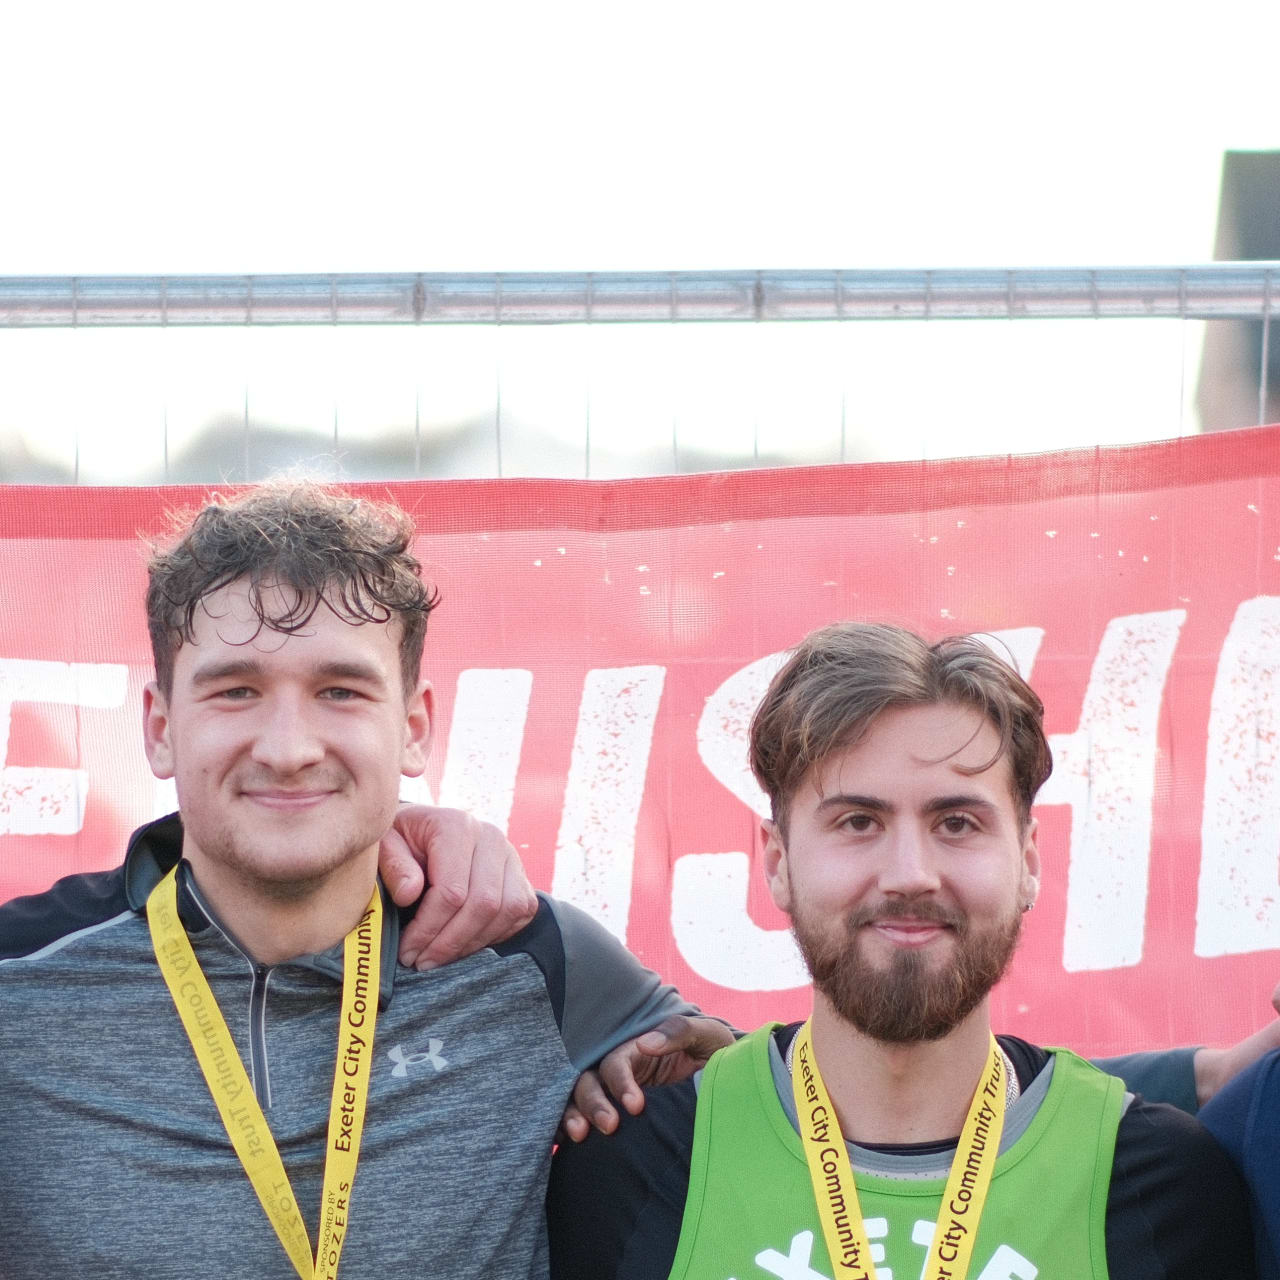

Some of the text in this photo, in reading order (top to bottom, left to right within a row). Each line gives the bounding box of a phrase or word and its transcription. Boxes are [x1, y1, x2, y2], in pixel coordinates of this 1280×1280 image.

[343, 1033, 366, 1077] City
[983, 1052, 1003, 1099] Trust
[335, 1082, 356, 1152] Exeter
[798, 1041, 819, 1103] Exeter
[810, 1105, 830, 1144] City
[820, 1147, 861, 1271] Community
[950, 1102, 996, 1216] Community
[321, 1207, 334, 1272] SPONSORED
[938, 1218, 968, 1262] City
